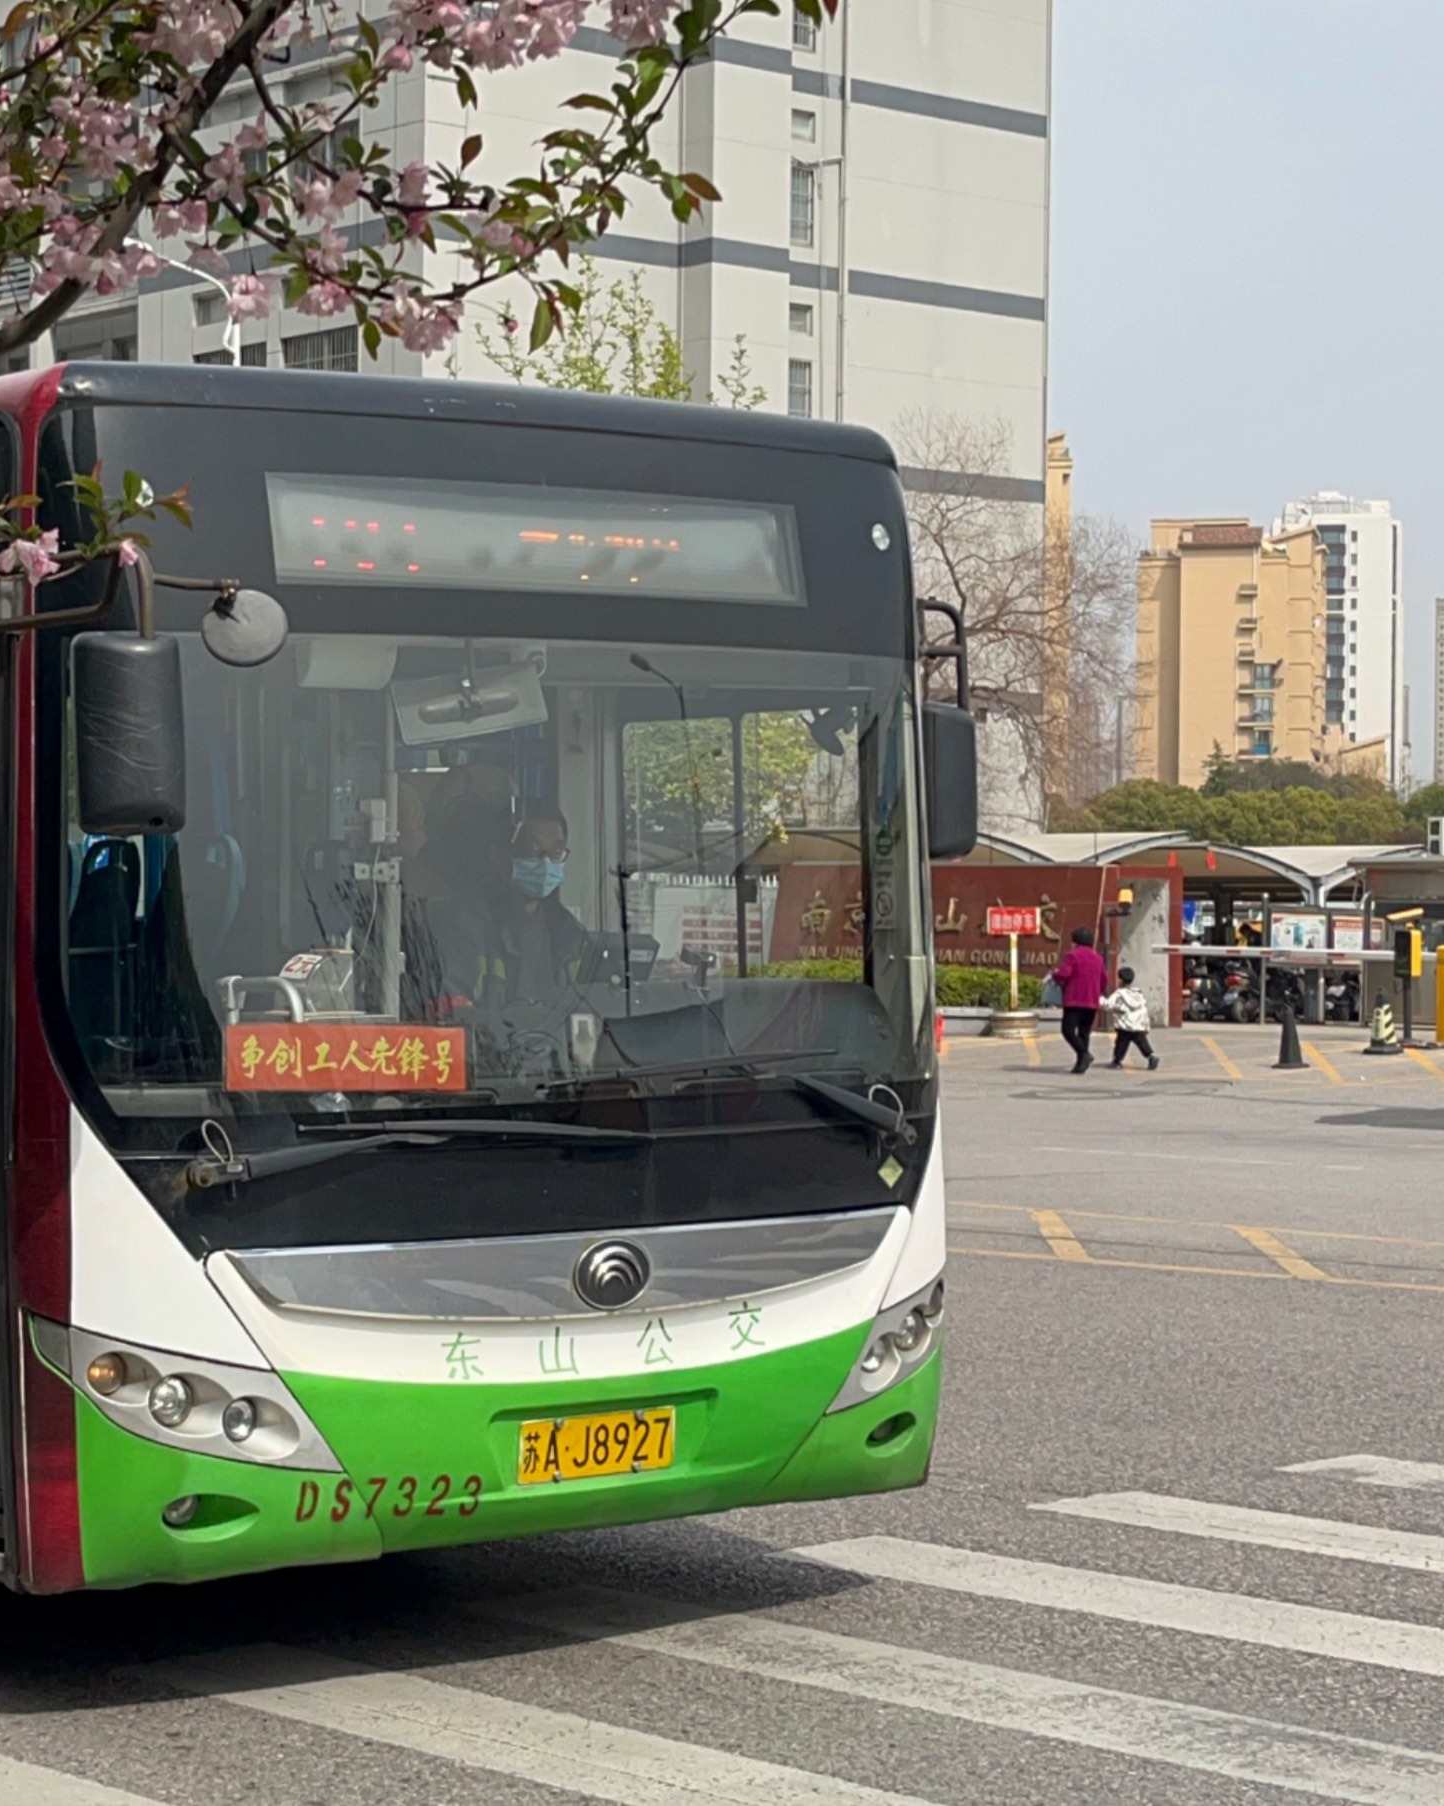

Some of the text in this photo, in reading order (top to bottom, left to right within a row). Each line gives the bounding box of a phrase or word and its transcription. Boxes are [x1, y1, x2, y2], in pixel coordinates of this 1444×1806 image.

[284, 956, 314, 974] 2元
[240, 1033, 454, 1085] 争创工人先锋号
[440, 1300, 767, 1381] 东山公交
[295, 1474, 482, 1524] DS7323
